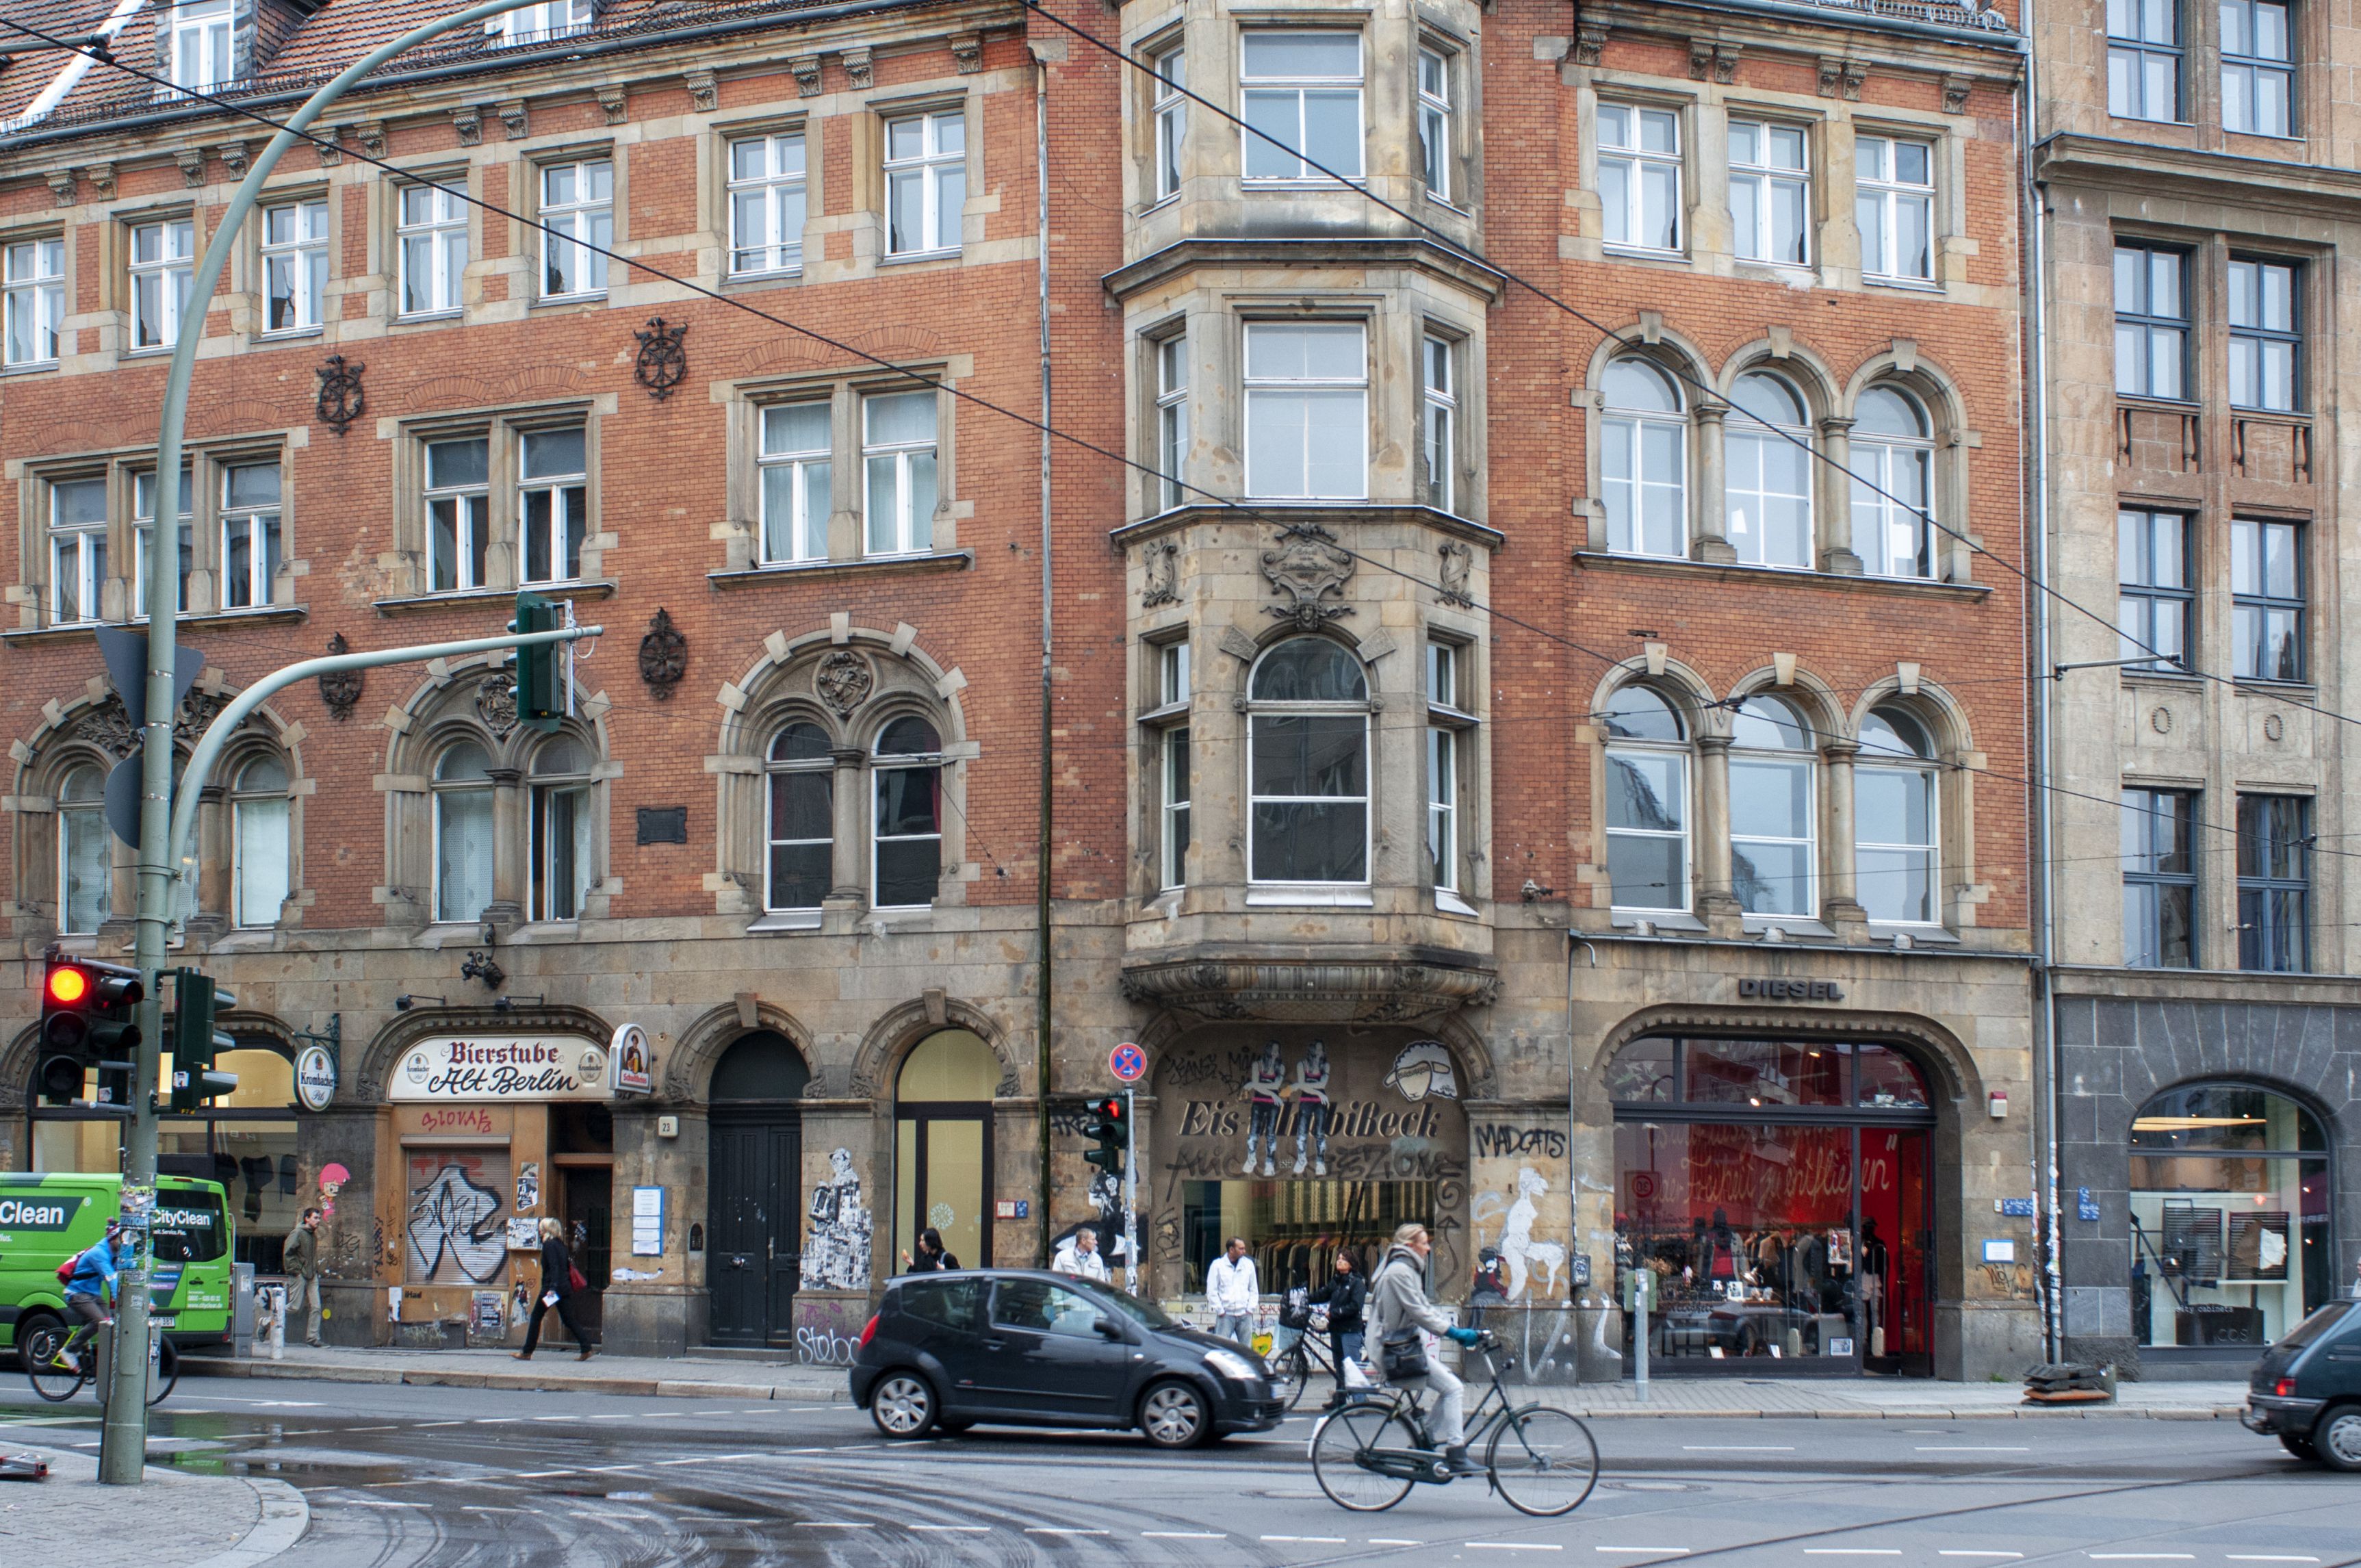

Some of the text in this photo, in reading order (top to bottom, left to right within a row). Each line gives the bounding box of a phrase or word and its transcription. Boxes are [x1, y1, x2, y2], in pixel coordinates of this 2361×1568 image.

[1739, 979, 1845, 1000] DIESEL
[441, 1040, 563, 1064] Bierstube
[301, 1072, 333, 1087] Krombacher
[428, 1066, 579, 1094] Alt Berlin
[662, 1123, 670, 1131] 23
[0, 1200, 64, 1224] Clean
[153, 1210, 210, 1226] CityClean
[2197, 1304, 2234, 1313] cabinets
[2217, 1328, 2249, 1341] COS
